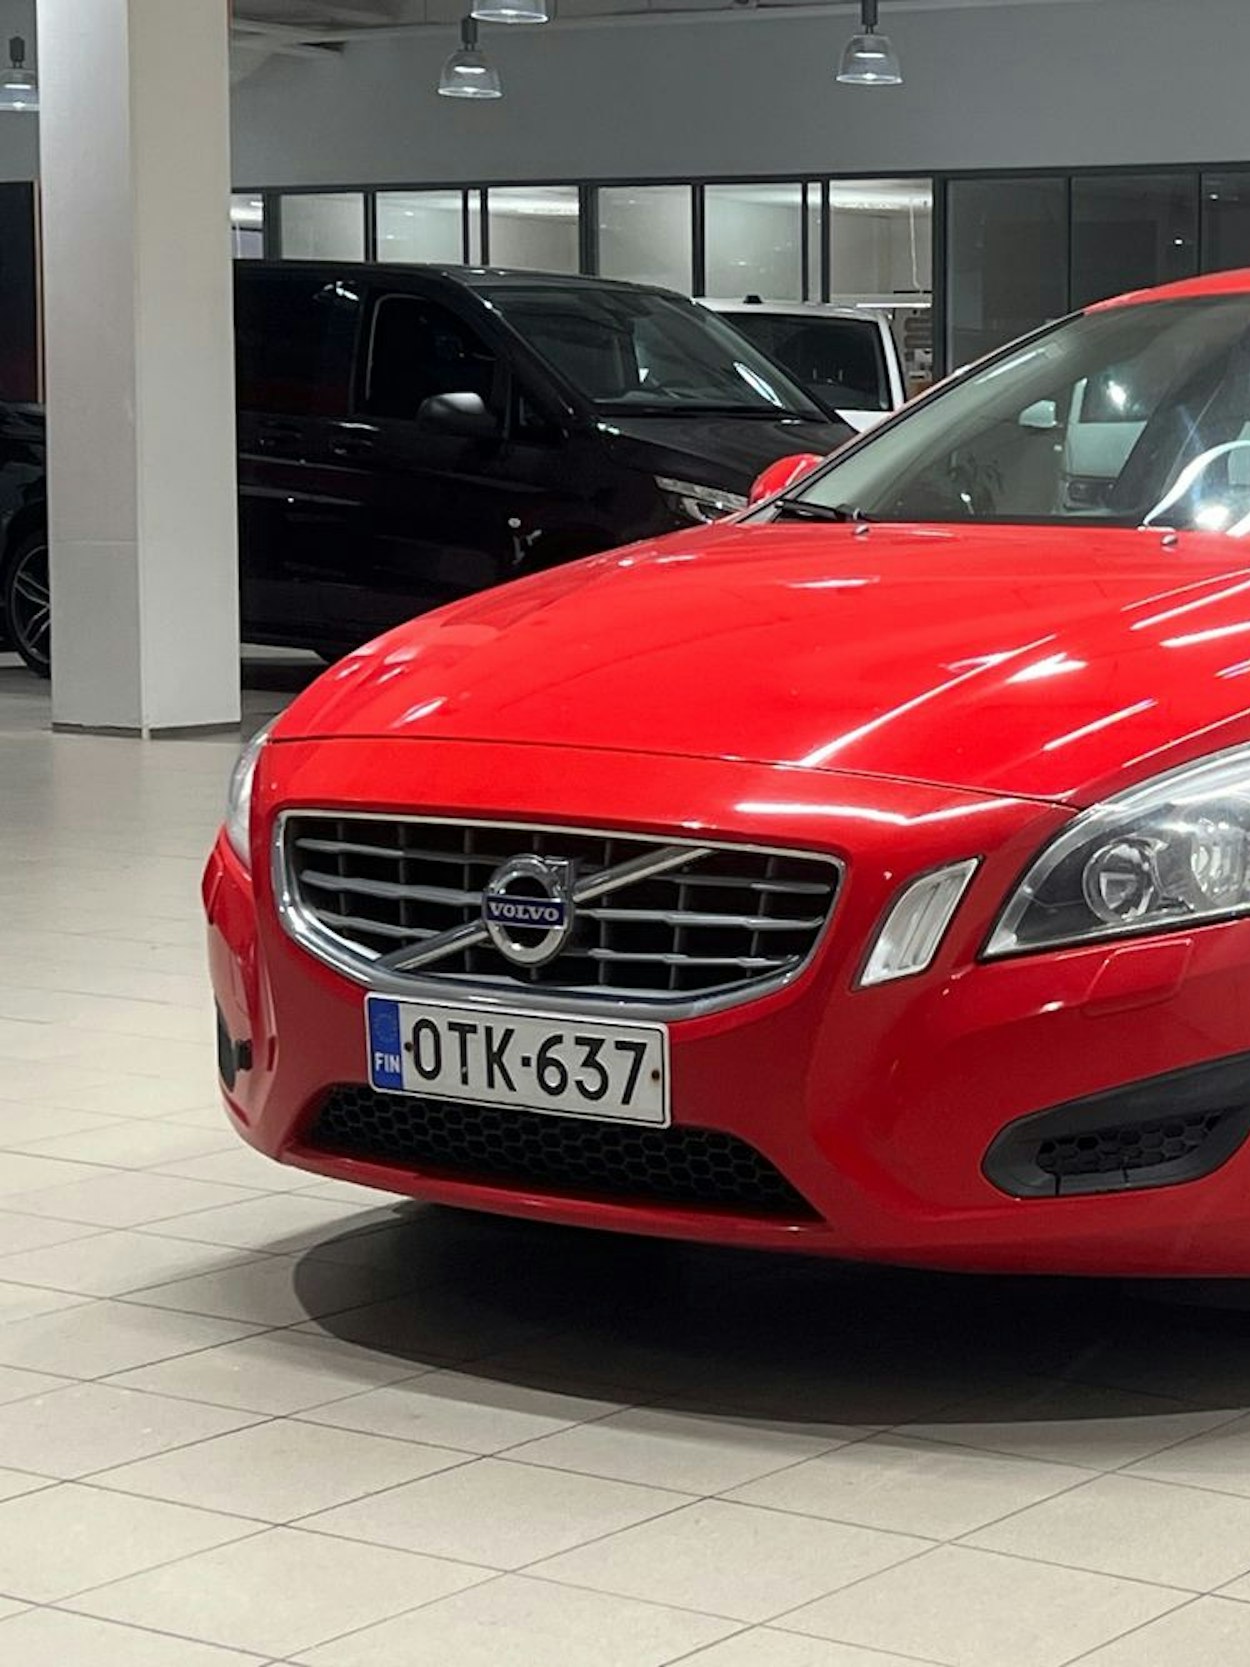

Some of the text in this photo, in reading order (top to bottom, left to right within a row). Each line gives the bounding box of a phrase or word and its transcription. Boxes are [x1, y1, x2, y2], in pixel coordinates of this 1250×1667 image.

[488, 901, 560, 922] VOLVO
[374, 1051, 401, 1074] FIN
[412, 1018, 648, 1105] OTK-637
